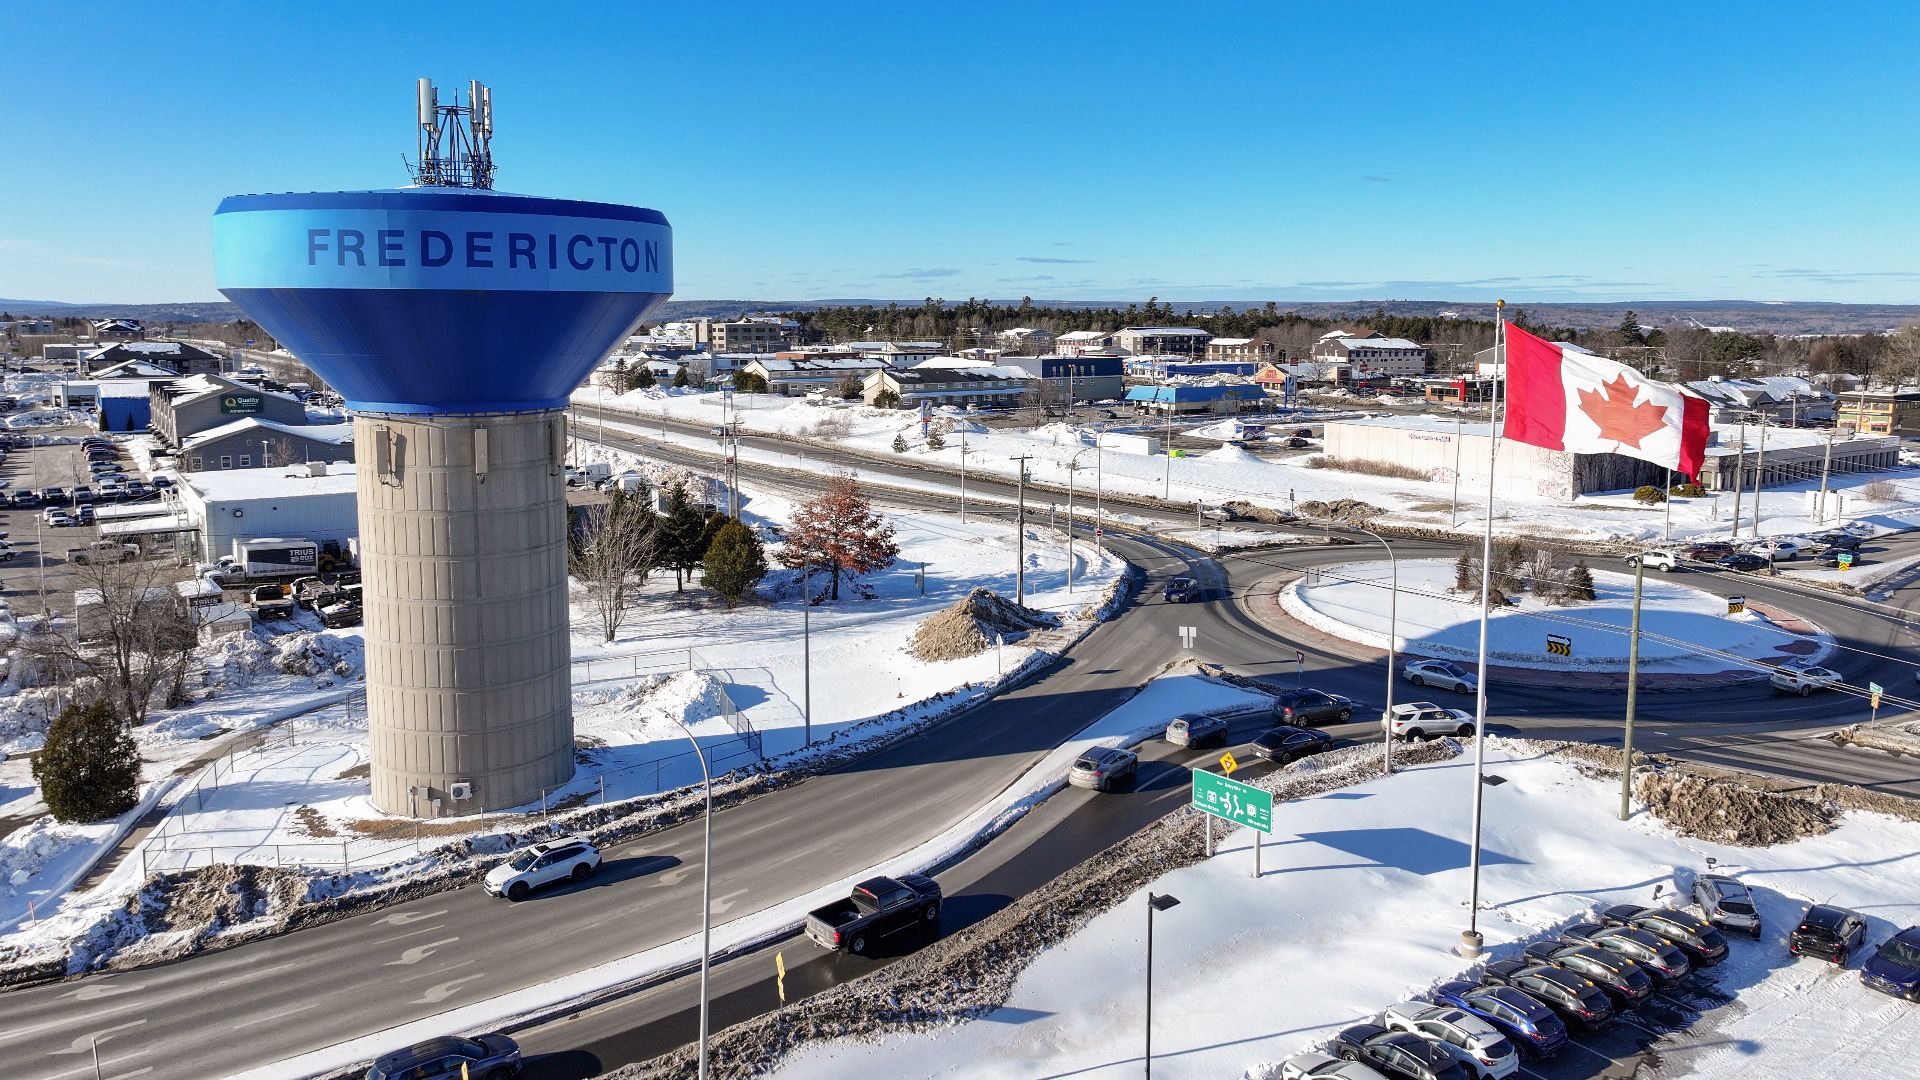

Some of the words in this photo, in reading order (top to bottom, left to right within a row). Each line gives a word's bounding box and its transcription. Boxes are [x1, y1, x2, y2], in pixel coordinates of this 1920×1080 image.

[307, 228, 660, 274] FREDERICTON
[289, 548, 314, 557] TRIUS
[220, 623, 244, 631] TRIUS
